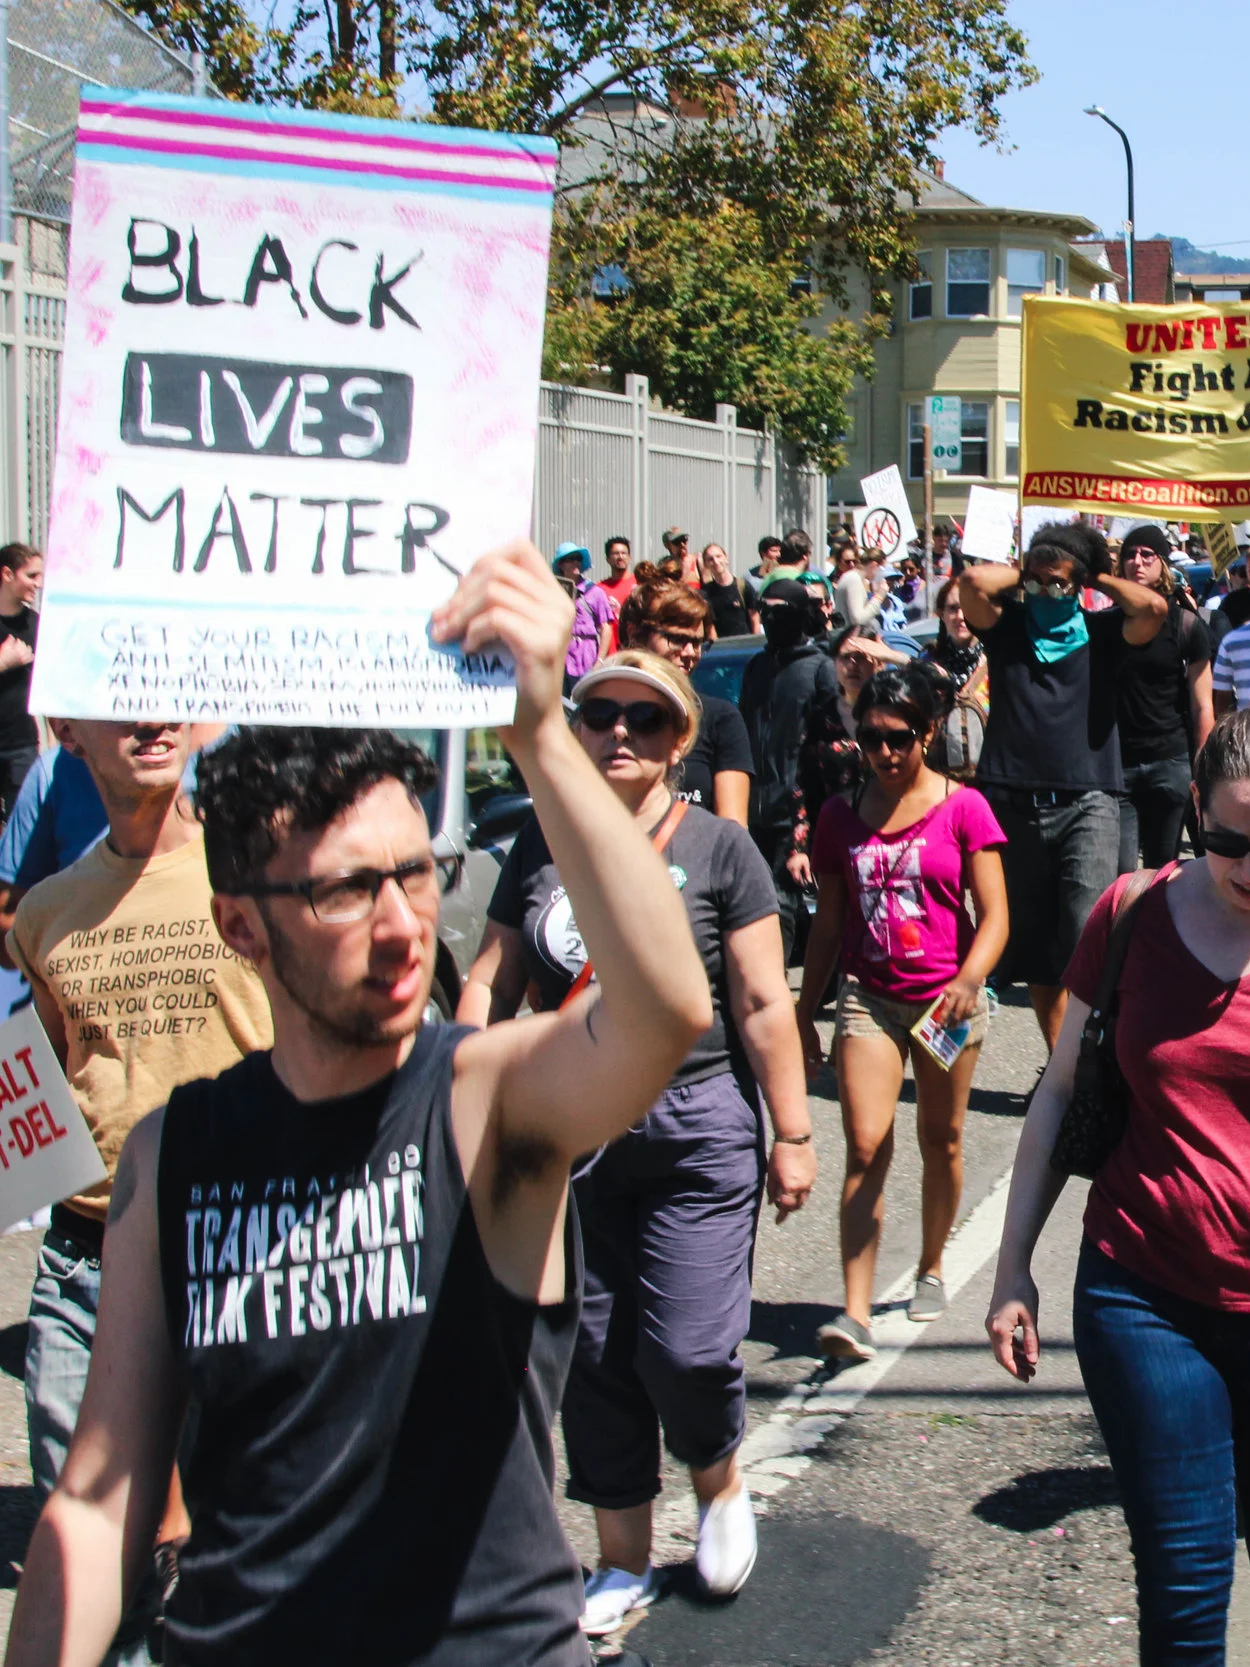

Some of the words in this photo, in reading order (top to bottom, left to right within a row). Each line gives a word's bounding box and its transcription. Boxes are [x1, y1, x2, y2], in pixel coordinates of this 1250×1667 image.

[121, 217, 424, 334] BLACK
[1129, 361, 1235, 401] Fight
[139, 360, 384, 459] LIVES
[1073, 399, 1229, 434] Racism
[112, 484, 465, 578] MATTER
[101, 618, 169, 649] GET
[189, 625, 271, 652] YOUR
[290, 626, 420, 654] RACISM,
[112, 695, 160, 714] AND
[70, 929, 109, 949] WHY
[113, 926, 137, 944] BE
[142, 919, 210, 941] RACIST,
[48, 954, 104, 977] SEXIST,
[61, 979, 82, 997] OR
[88, 968, 217, 993] TRANSPHOBIC
[115, 996, 147, 1015] YOU
[152, 992, 218, 1011] COULD
[78, 1024, 110, 1043] JUST
[117, 1022, 136, 1039] BE
[140, 1016, 207, 1036] QUIET?
[185, 1169, 425, 1277] TRANSGENDER
[264, 1243, 427, 1340] FESTIVAL
